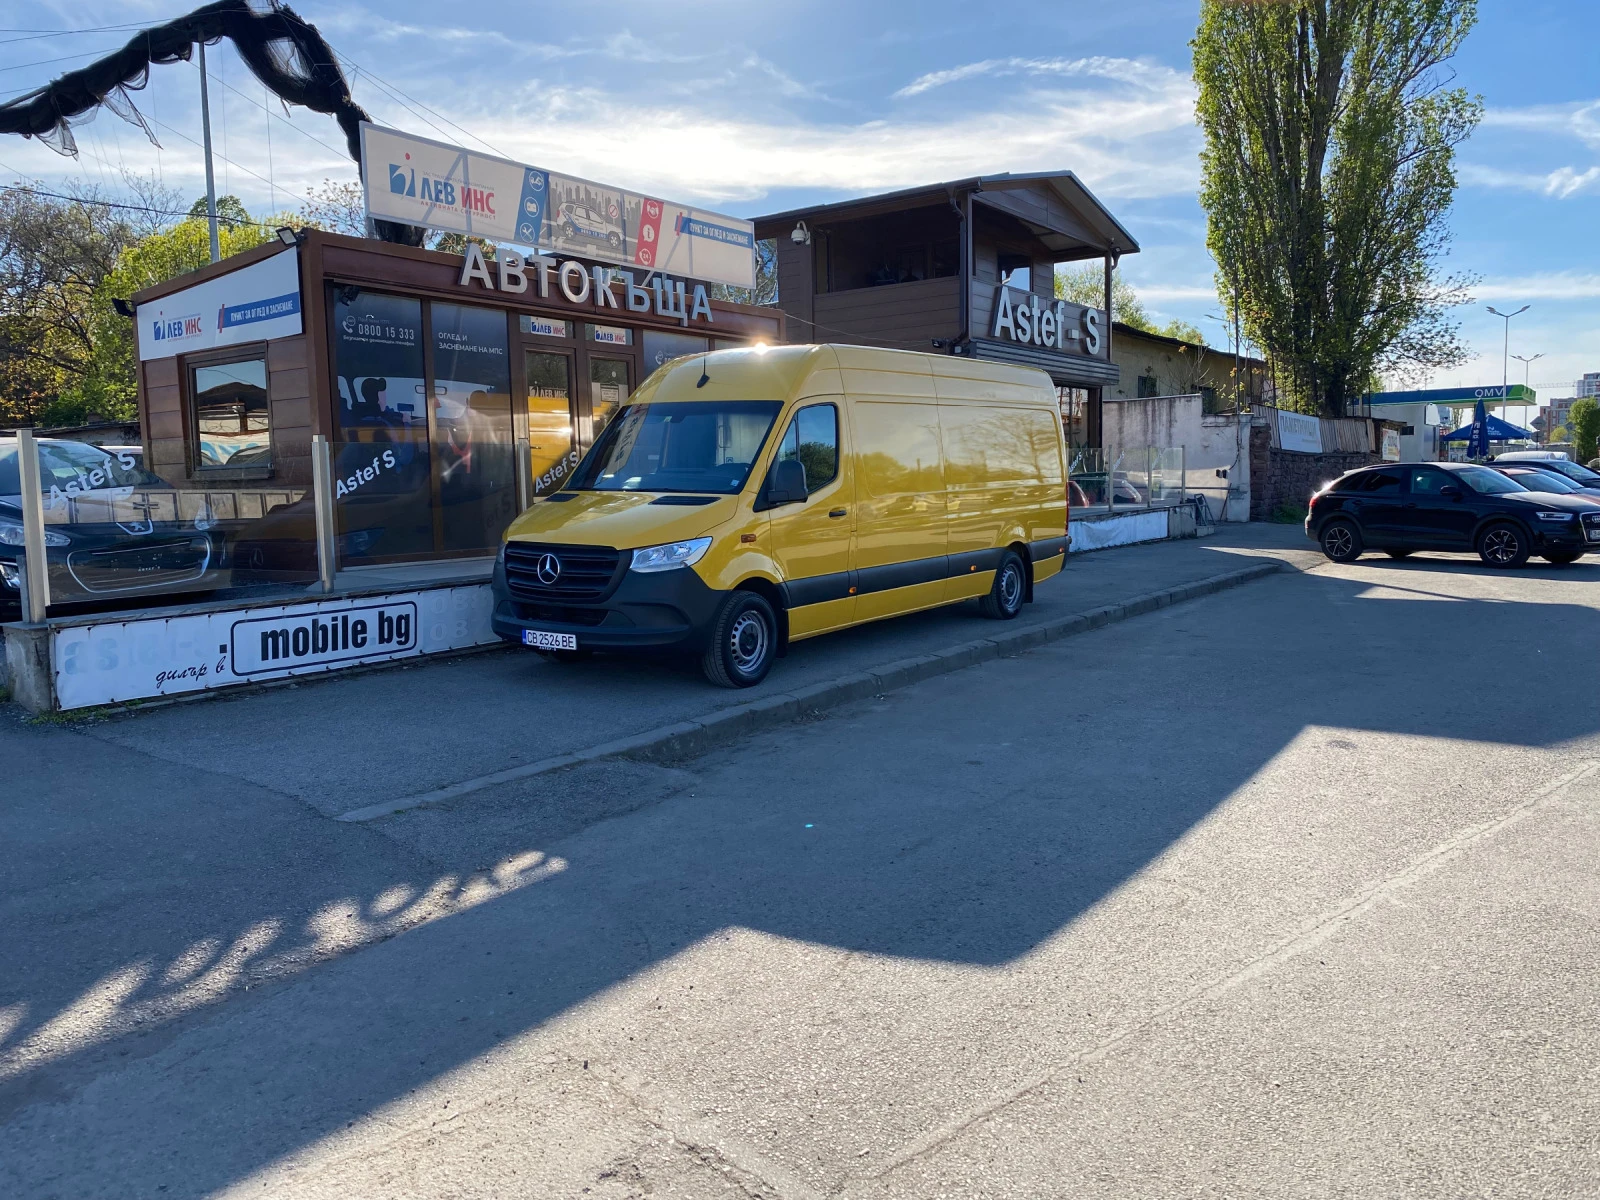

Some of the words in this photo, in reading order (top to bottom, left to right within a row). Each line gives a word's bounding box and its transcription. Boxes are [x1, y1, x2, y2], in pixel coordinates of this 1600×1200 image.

[421, 177, 456, 206] ЛЕВ
[461, 186, 496, 214] ИНС
[458, 242, 714, 327] АВТОКЪЩА
[230, 310, 245, 322] ПУНКТ
[245, 309, 251, 319] ЗА
[251, 306, 266, 319] ОГЛЕД
[269, 300, 294, 314] ЗАСНЕМАНЕ
[992, 284, 1065, 349] Astef
[1082, 308, 1101, 355] S
[167, 320, 183, 339] ЛЕВ
[185, 317, 202, 335] ИНС
[358, 323, 381, 337] 0800
[385, 326, 396, 338] 15
[398, 328, 415, 340] 333
[438, 332, 461, 342] ОГЛЕД
[540, 325, 552, 334] ЛЕВ
[603, 331, 614, 341] ЛЕВ
[438, 342, 478, 353] ЗАСНЕМАНЕ
[488, 347, 503, 355] МПС
[1474, 387, 1505, 398] OMV
[50, 457, 113, 509] Astef
[117, 449, 136, 471] S
[336, 457, 380, 500] Astef
[382, 449, 396, 469] S
[535, 458, 568, 493] Astef
[569, 451, 579, 468] S
[260, 614, 368, 662] mobile
[377, 610, 411, 646] bg
[539, 633, 561, 647] 2526
[155, 663, 208, 689] дилър
